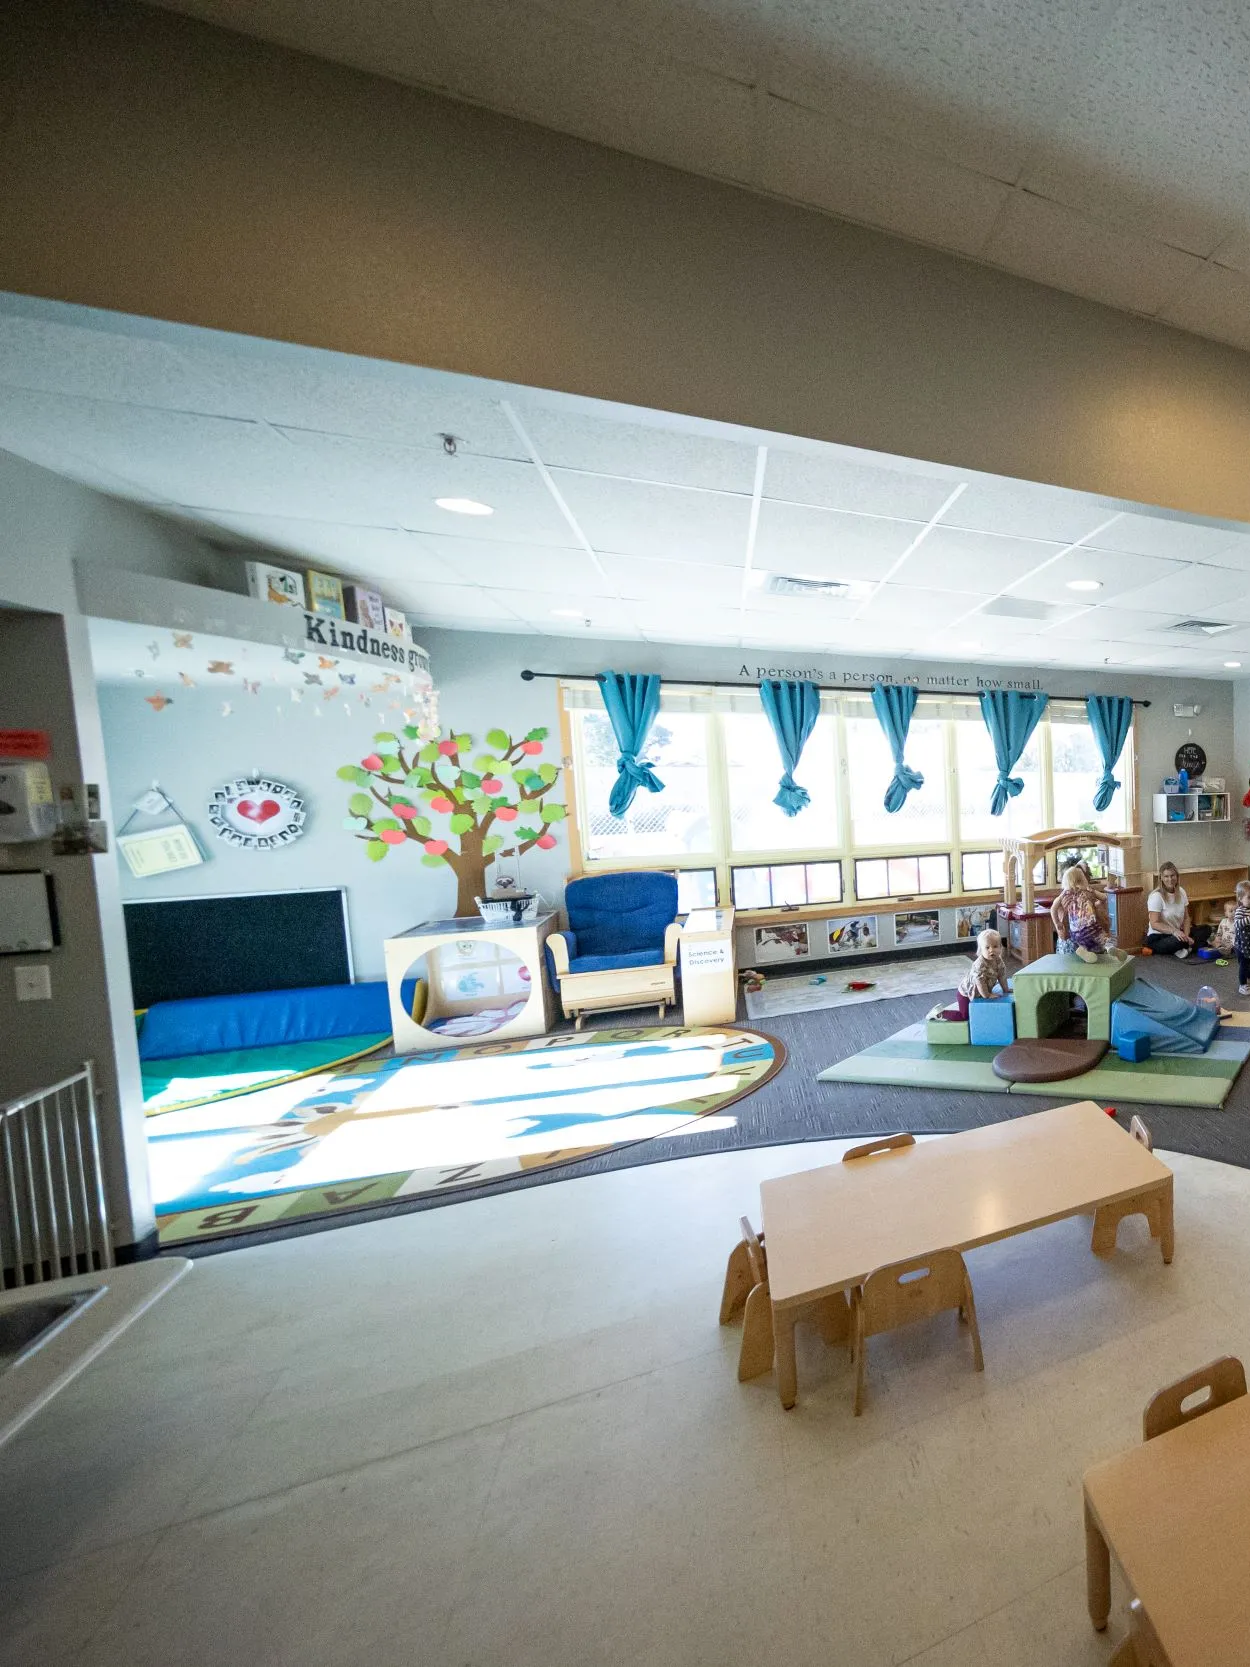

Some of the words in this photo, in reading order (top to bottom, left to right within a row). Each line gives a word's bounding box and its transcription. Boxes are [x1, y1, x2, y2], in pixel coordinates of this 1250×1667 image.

[303, 614, 406, 665] Kindness
[738, 664, 750, 677] A
[756, 666, 824, 680] person's
[829, 671, 837, 680] a
[927, 674, 969, 687] matter
[976, 676, 1002, 688] how
[1007, 679, 1044, 690] small.
[688, 949, 718, 958] Science
[689, 958, 725, 966] Discovery
